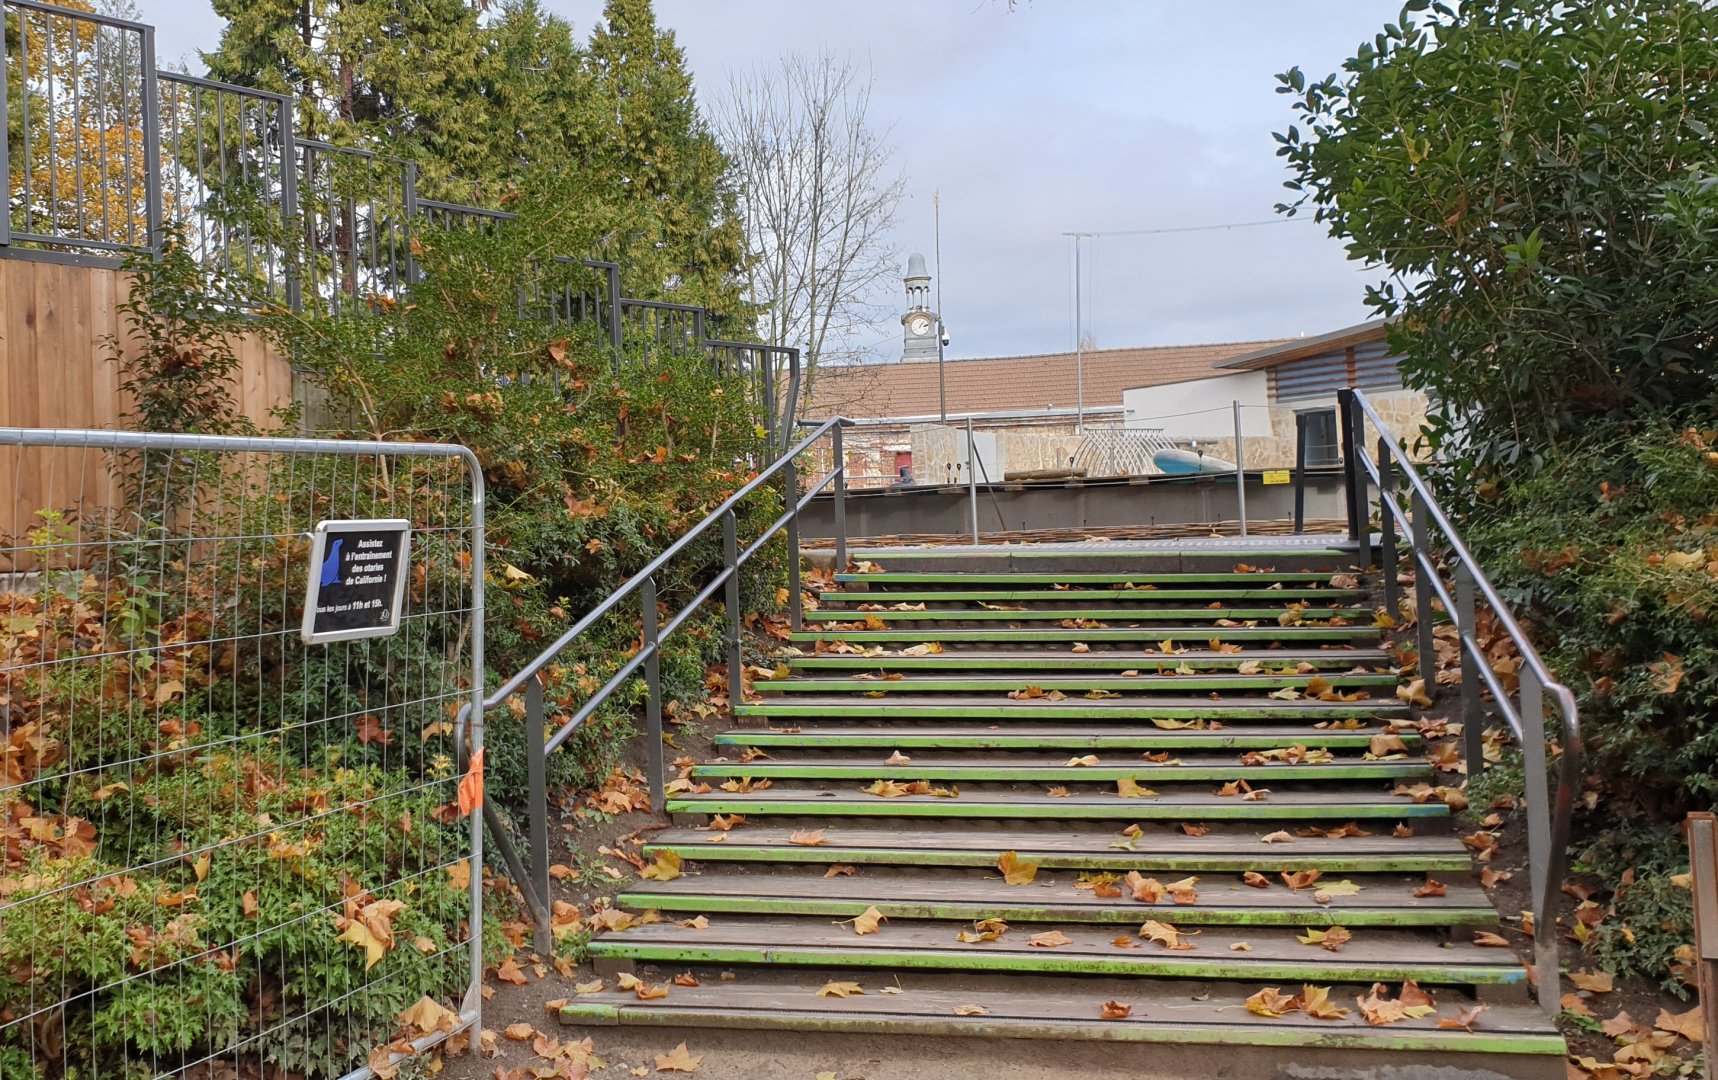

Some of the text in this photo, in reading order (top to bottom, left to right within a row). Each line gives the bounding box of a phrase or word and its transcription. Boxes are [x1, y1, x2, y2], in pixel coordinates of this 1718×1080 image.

[358, 539, 383, 548] Assistez
[346, 552, 350, 561] à
[352, 563, 384, 573] des otaries
[346, 576, 354, 585] de
[355, 574, 382, 585] Californie
[334, 605, 347, 613] jours
[353, 601, 363, 609] 11h
[364, 600, 370, 608] et
